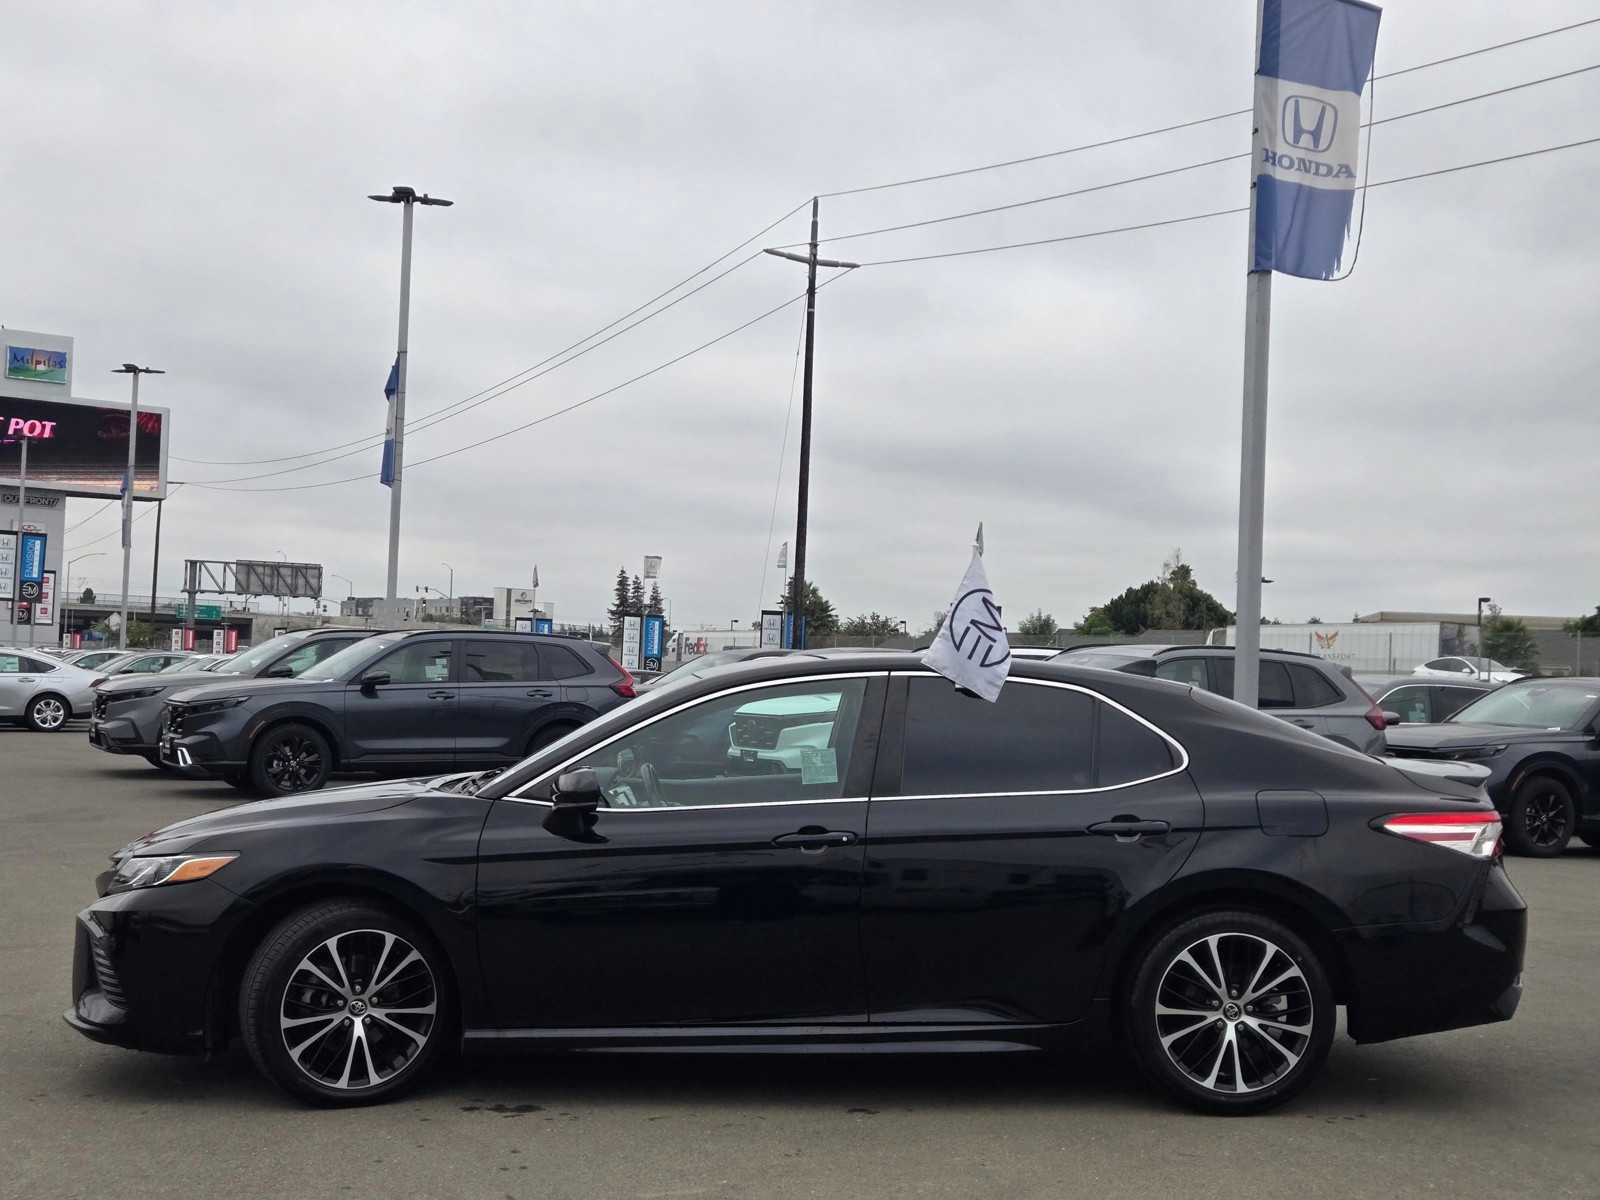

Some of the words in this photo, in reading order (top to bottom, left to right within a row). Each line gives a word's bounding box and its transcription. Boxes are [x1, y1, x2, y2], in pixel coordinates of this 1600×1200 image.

[1262, 147, 1357, 179] HONDA
[7, 417, 57, 438] POT
[684, 636, 708, 655] FedEx
